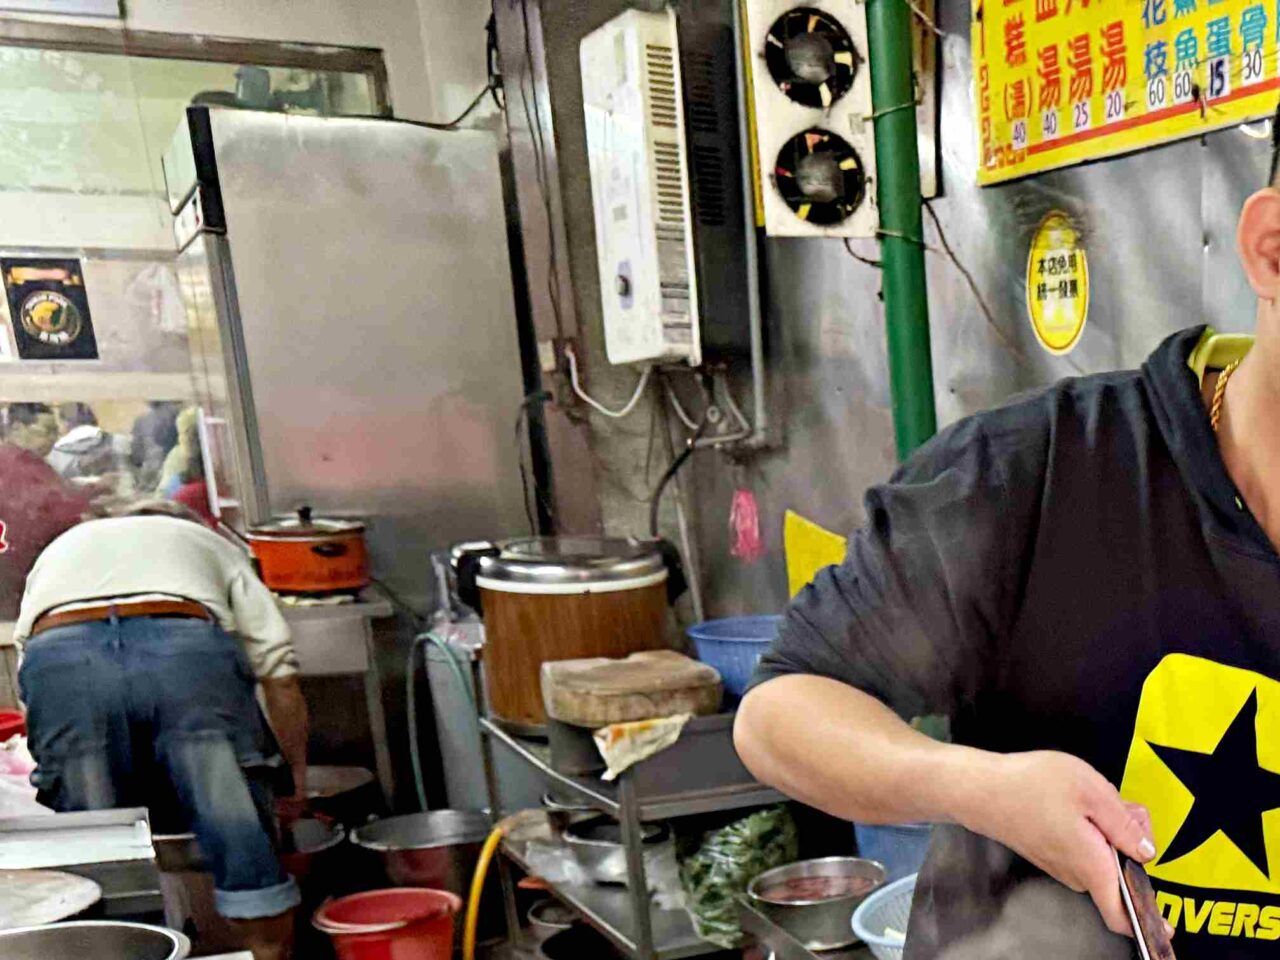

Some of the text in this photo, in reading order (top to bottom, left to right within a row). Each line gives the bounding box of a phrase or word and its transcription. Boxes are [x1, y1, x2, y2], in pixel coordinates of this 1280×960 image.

[1209, 58, 1225, 97] 15
[1242, 50, 1262, 80] 30
[1149, 78, 1165, 106] 60
[1174, 71, 1191, 98] 60
[1074, 102, 1089, 128] 25
[1106, 91, 1122, 119] 20
